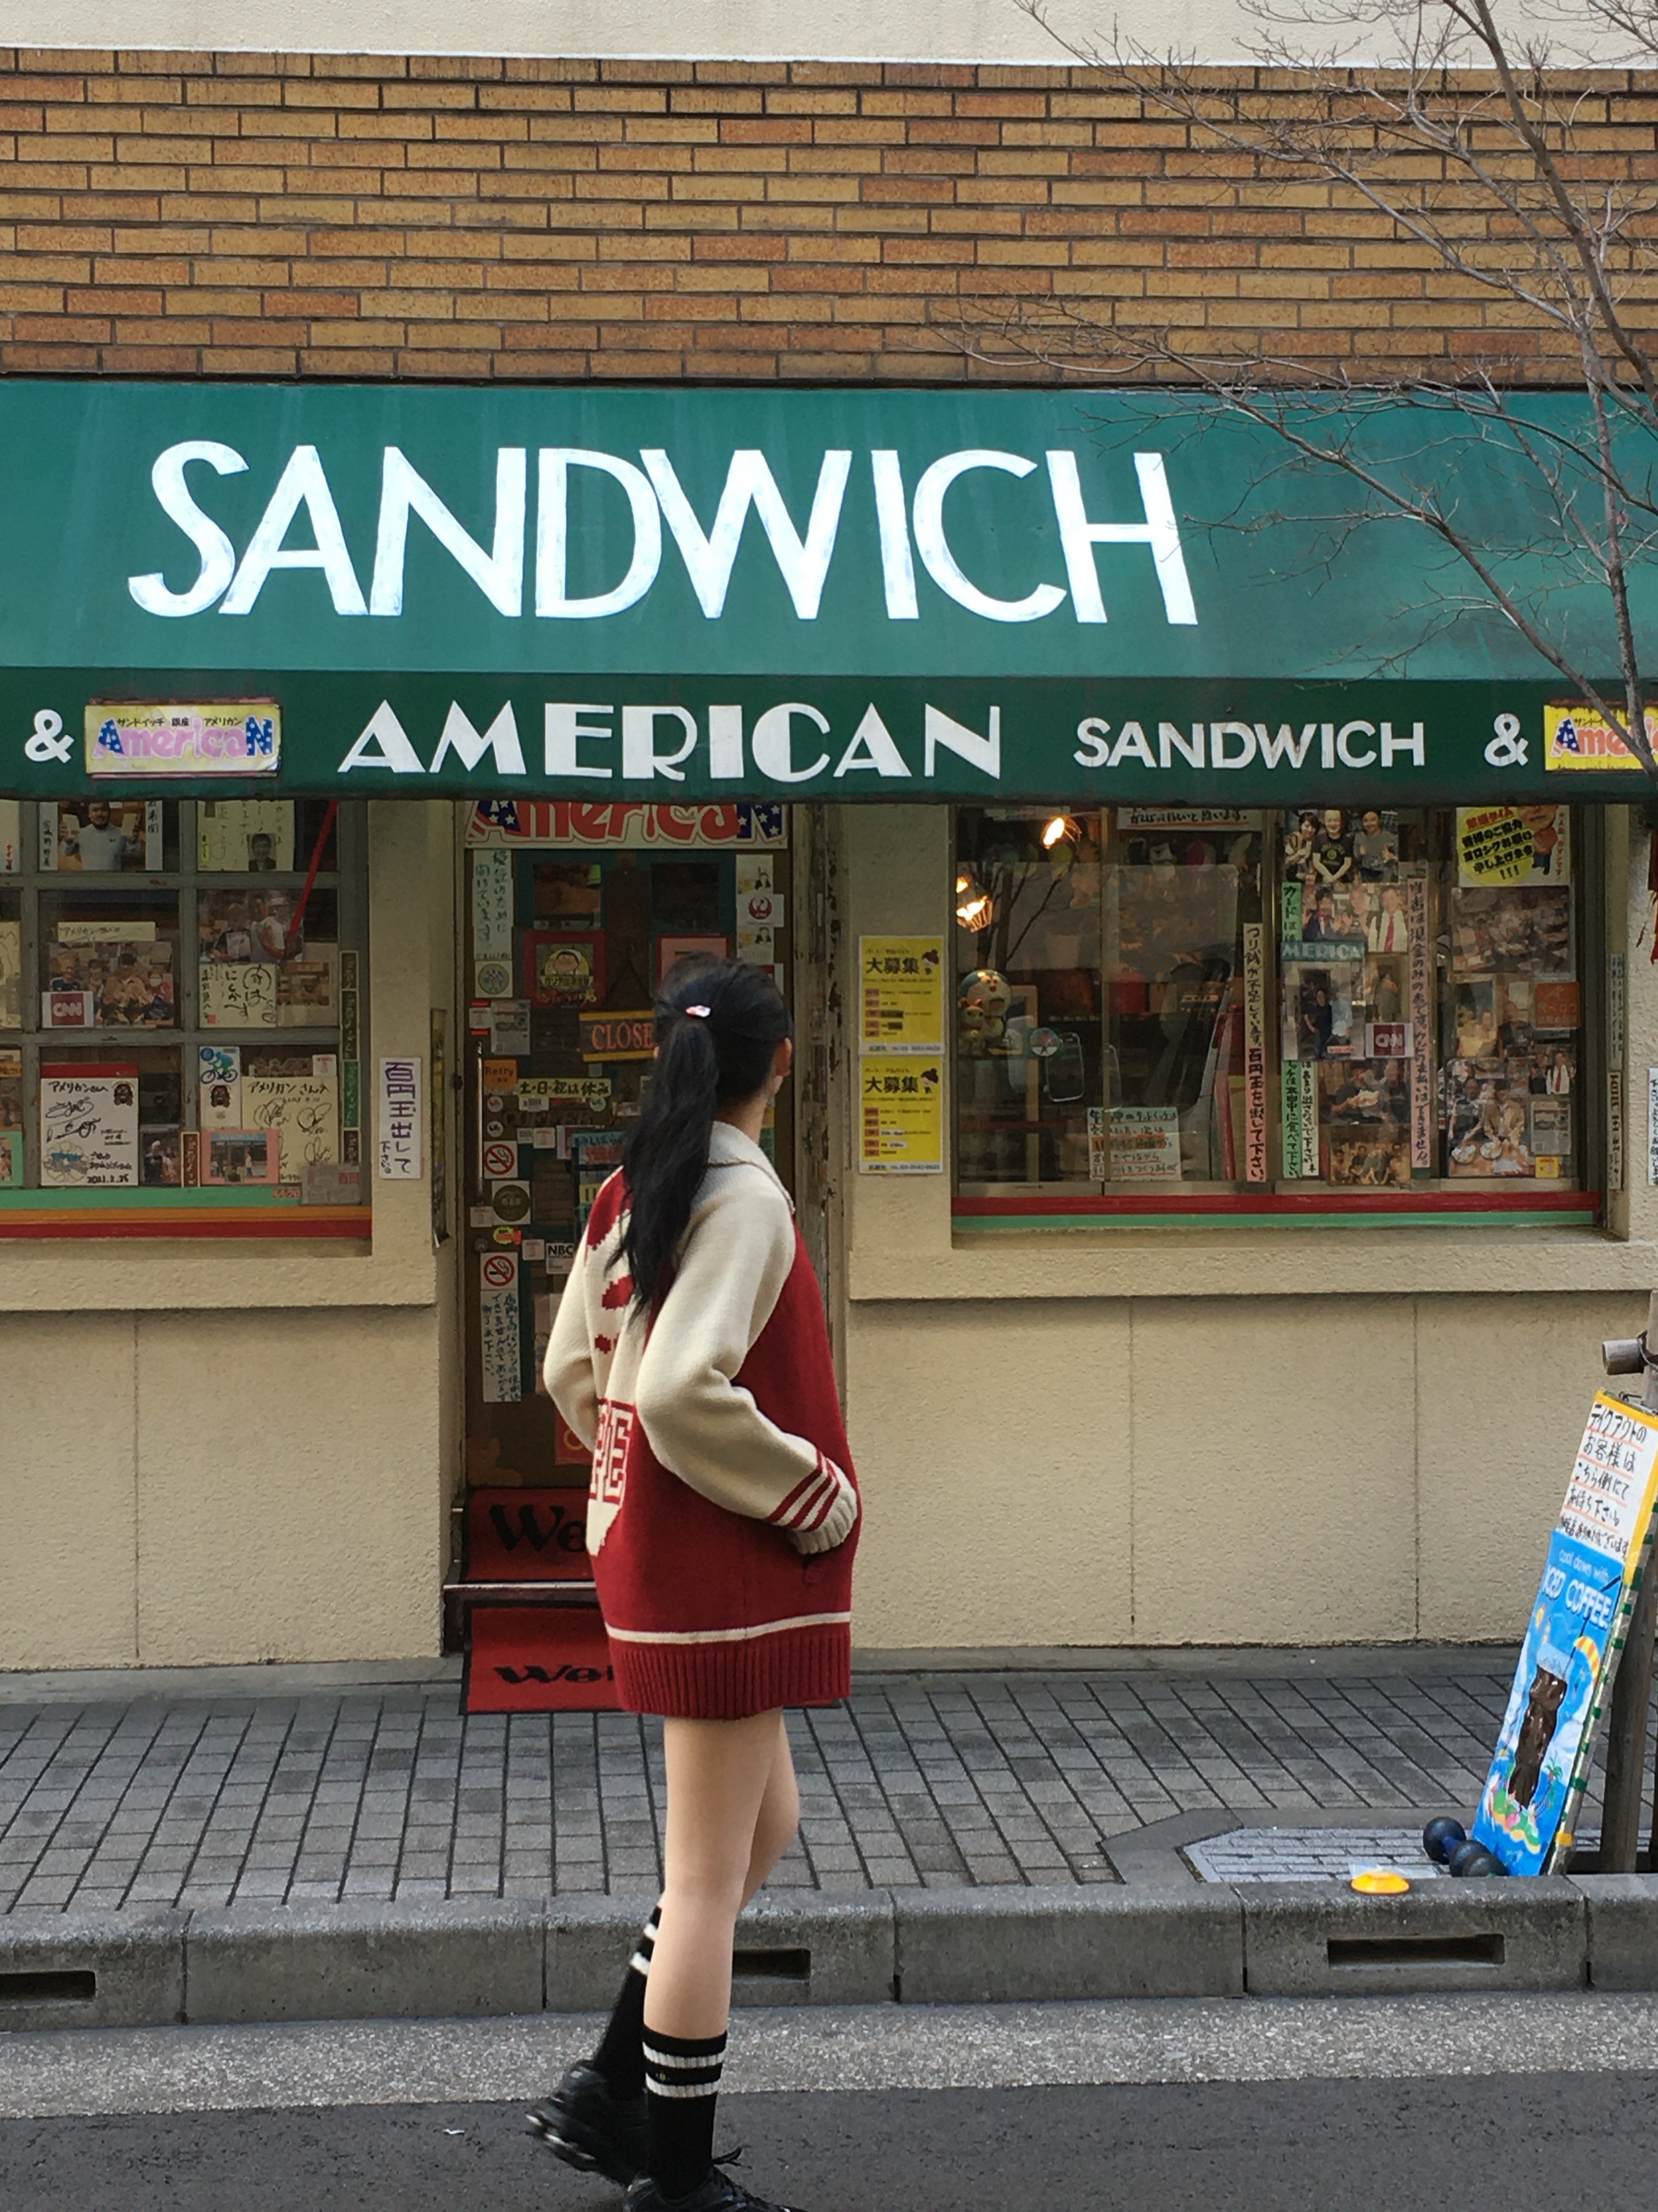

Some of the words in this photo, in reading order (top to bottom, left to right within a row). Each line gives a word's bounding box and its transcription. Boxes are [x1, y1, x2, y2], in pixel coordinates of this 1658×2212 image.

[128, 440, 1198, 625] SANDWICH
[25, 709, 74, 763] &
[338, 700, 1000, 783] AMERICAN
[1074, 717, 1425, 769] SANDWICH
[1485, 713, 1529, 767] &
[866, 957, 920, 975] 大募集
[53, 1002, 83, 1017] CNN
[591, 1022, 657, 1051] CLOSE
[1375, 1033, 1403, 1048] CNN
[865, 1076, 920, 1094] 大募集
[548, 1245, 574, 1256] NBC
[1583, 1434, 1636, 1473] お客様は
[1575, 1461, 1630, 1501] こちら側にて
[1567, 1486, 1620, 1528] お待ち下さい
[489, 1504, 587, 1552] We
[1565, 1578, 1613, 1629] COFFEE
[494, 1664, 615, 1684] We
